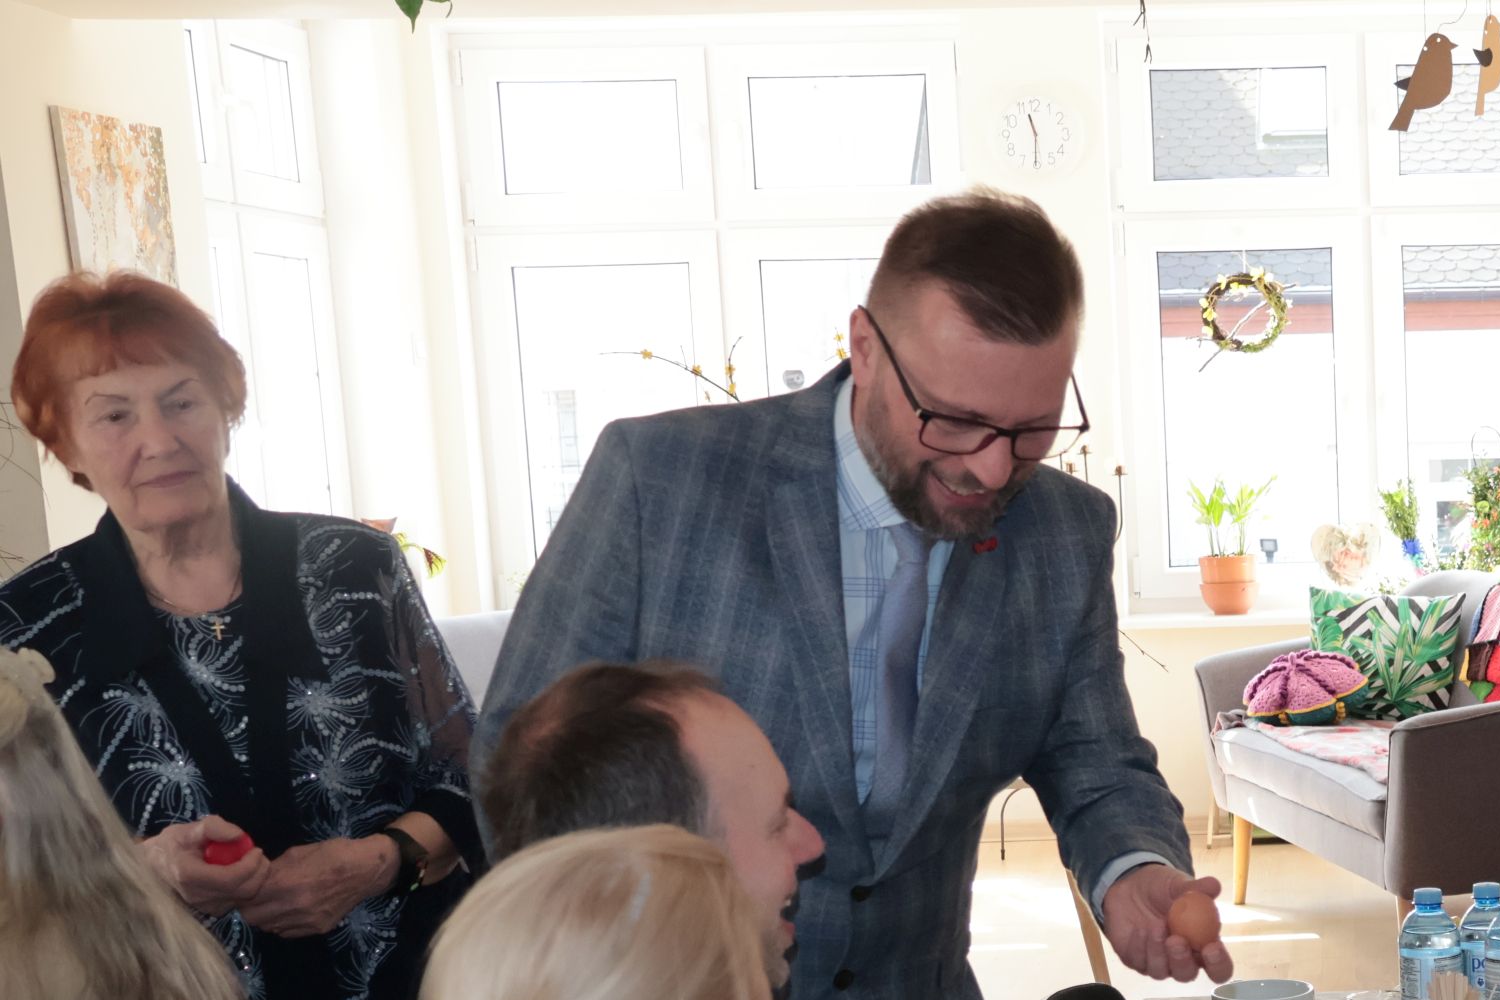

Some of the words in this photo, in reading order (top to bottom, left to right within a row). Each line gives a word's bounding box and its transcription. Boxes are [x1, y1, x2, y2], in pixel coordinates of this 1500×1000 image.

[1017, 102, 1025, 114] 11
[1029, 99, 1040, 112] 12
[1004, 114, 1017, 128] 10
[1056, 112, 1064, 125] 2
[1002, 130, 1010, 141] 9
[1062, 128, 1070, 141] 3
[1008, 143, 1015, 156] 8
[1057, 144, 1064, 156] 4
[1048, 152, 1055, 165] 5
